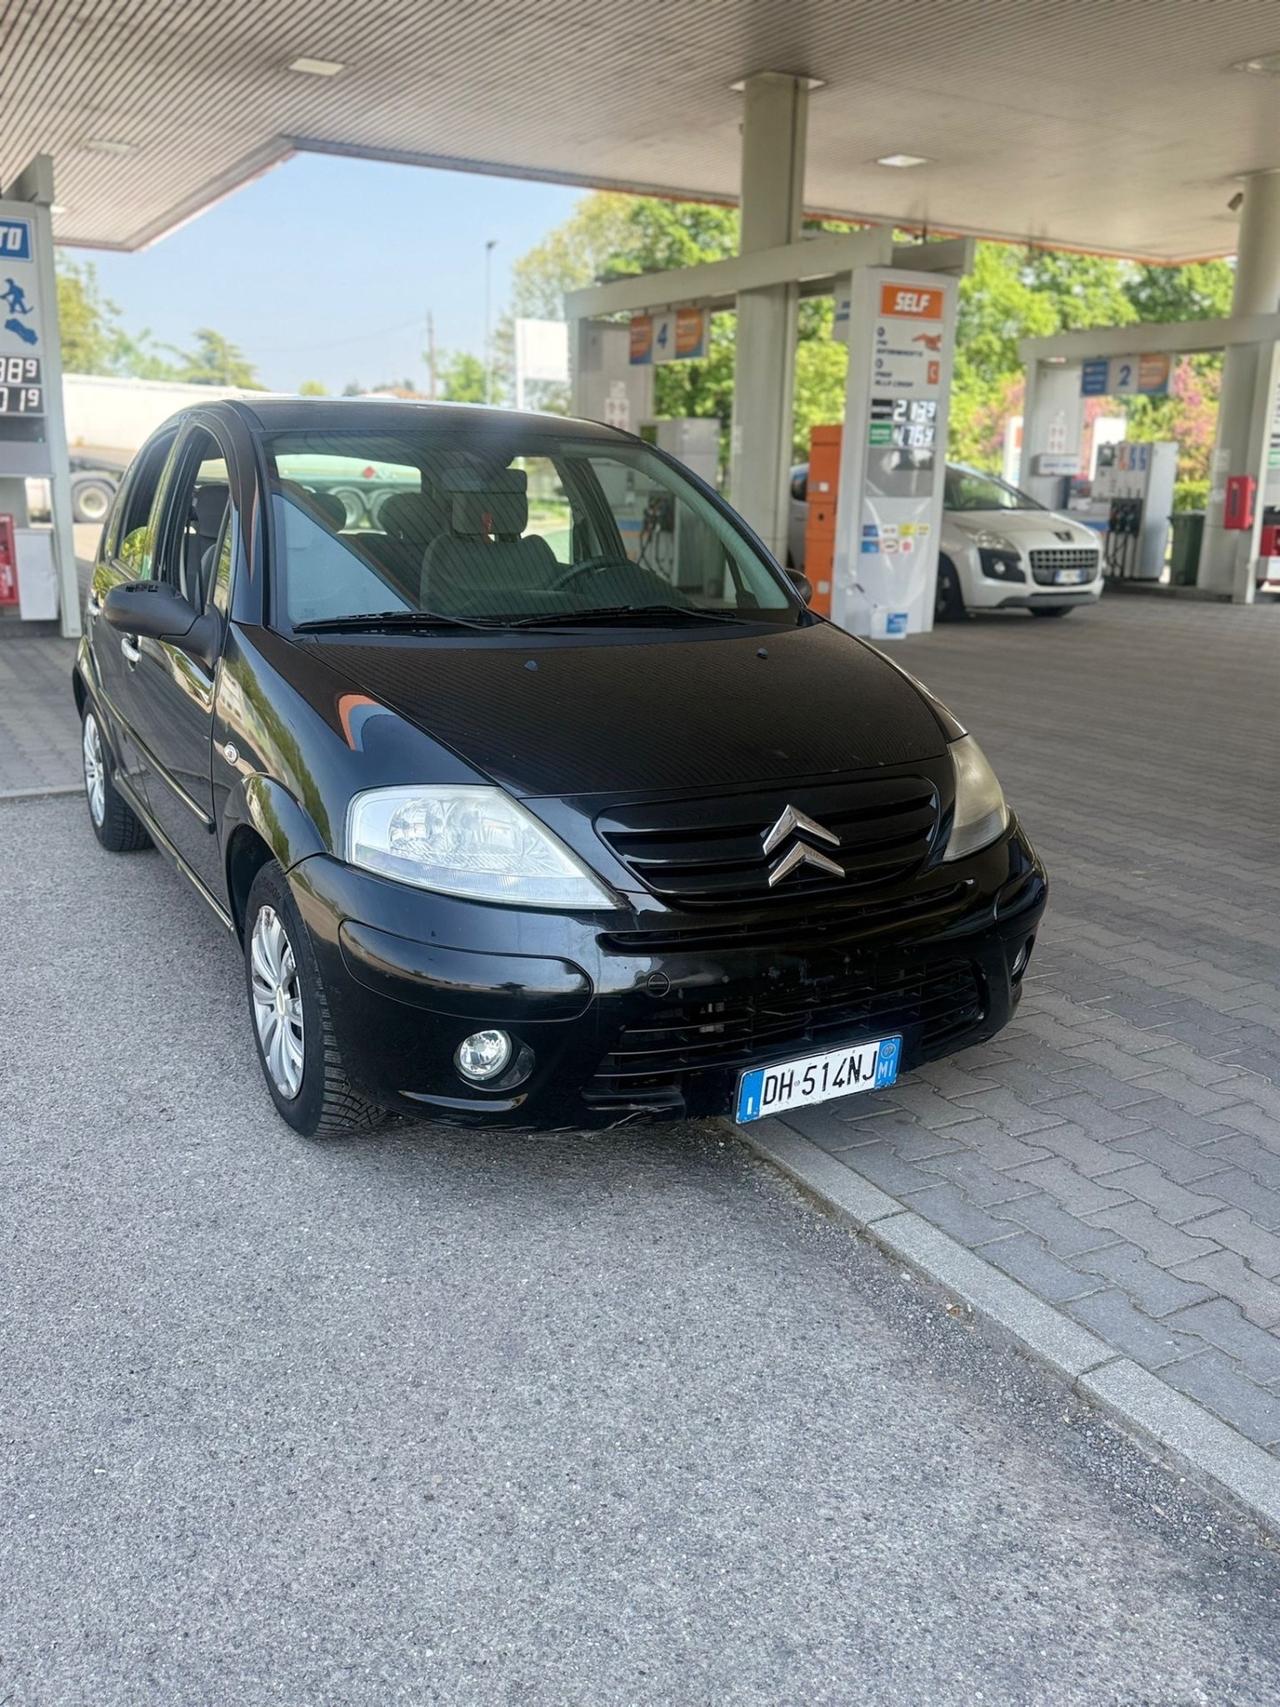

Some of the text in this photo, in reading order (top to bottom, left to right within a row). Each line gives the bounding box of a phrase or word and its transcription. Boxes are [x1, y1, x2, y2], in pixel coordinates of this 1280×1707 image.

[894, 292, 930, 312] SELF
[657, 322, 668, 349] 4
[1119, 364, 1132, 386] 2
[878, 1060, 894, 1080] MI
